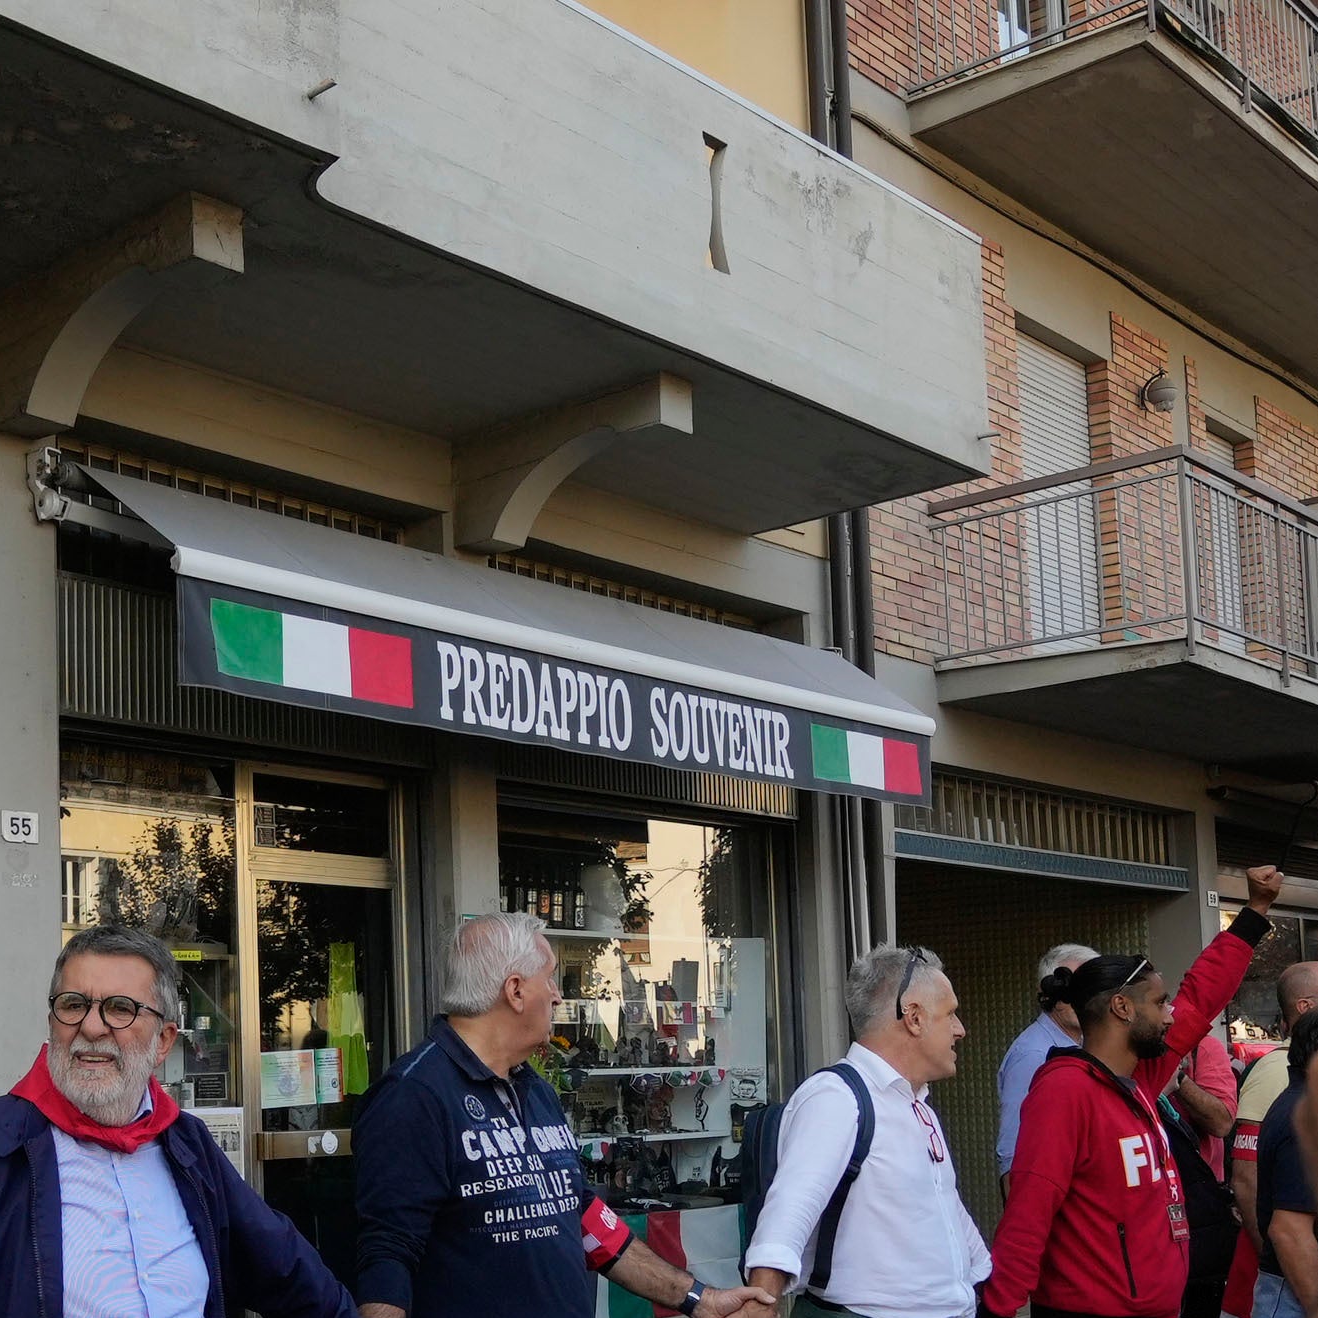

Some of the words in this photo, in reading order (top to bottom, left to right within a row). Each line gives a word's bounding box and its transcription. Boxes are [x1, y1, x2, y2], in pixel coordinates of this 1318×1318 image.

[437, 640, 633, 752] PREDAPPIO
[650, 685, 796, 780] SOUVENIR
[10, 816, 32, 836] 55
[461, 1126, 527, 1162] CAMP
[1233, 1133, 1259, 1151] RGANIZ
[486, 1157, 522, 1178] DEEP
[527, 1154, 545, 1172] SEA
[1118, 1132, 1169, 1188] FL
[460, 1173, 535, 1198] RESEARCH
[534, 1169, 574, 1200] BLUE
[492, 1232, 520, 1244] THE
[524, 1224, 559, 1240] PACIFIC
